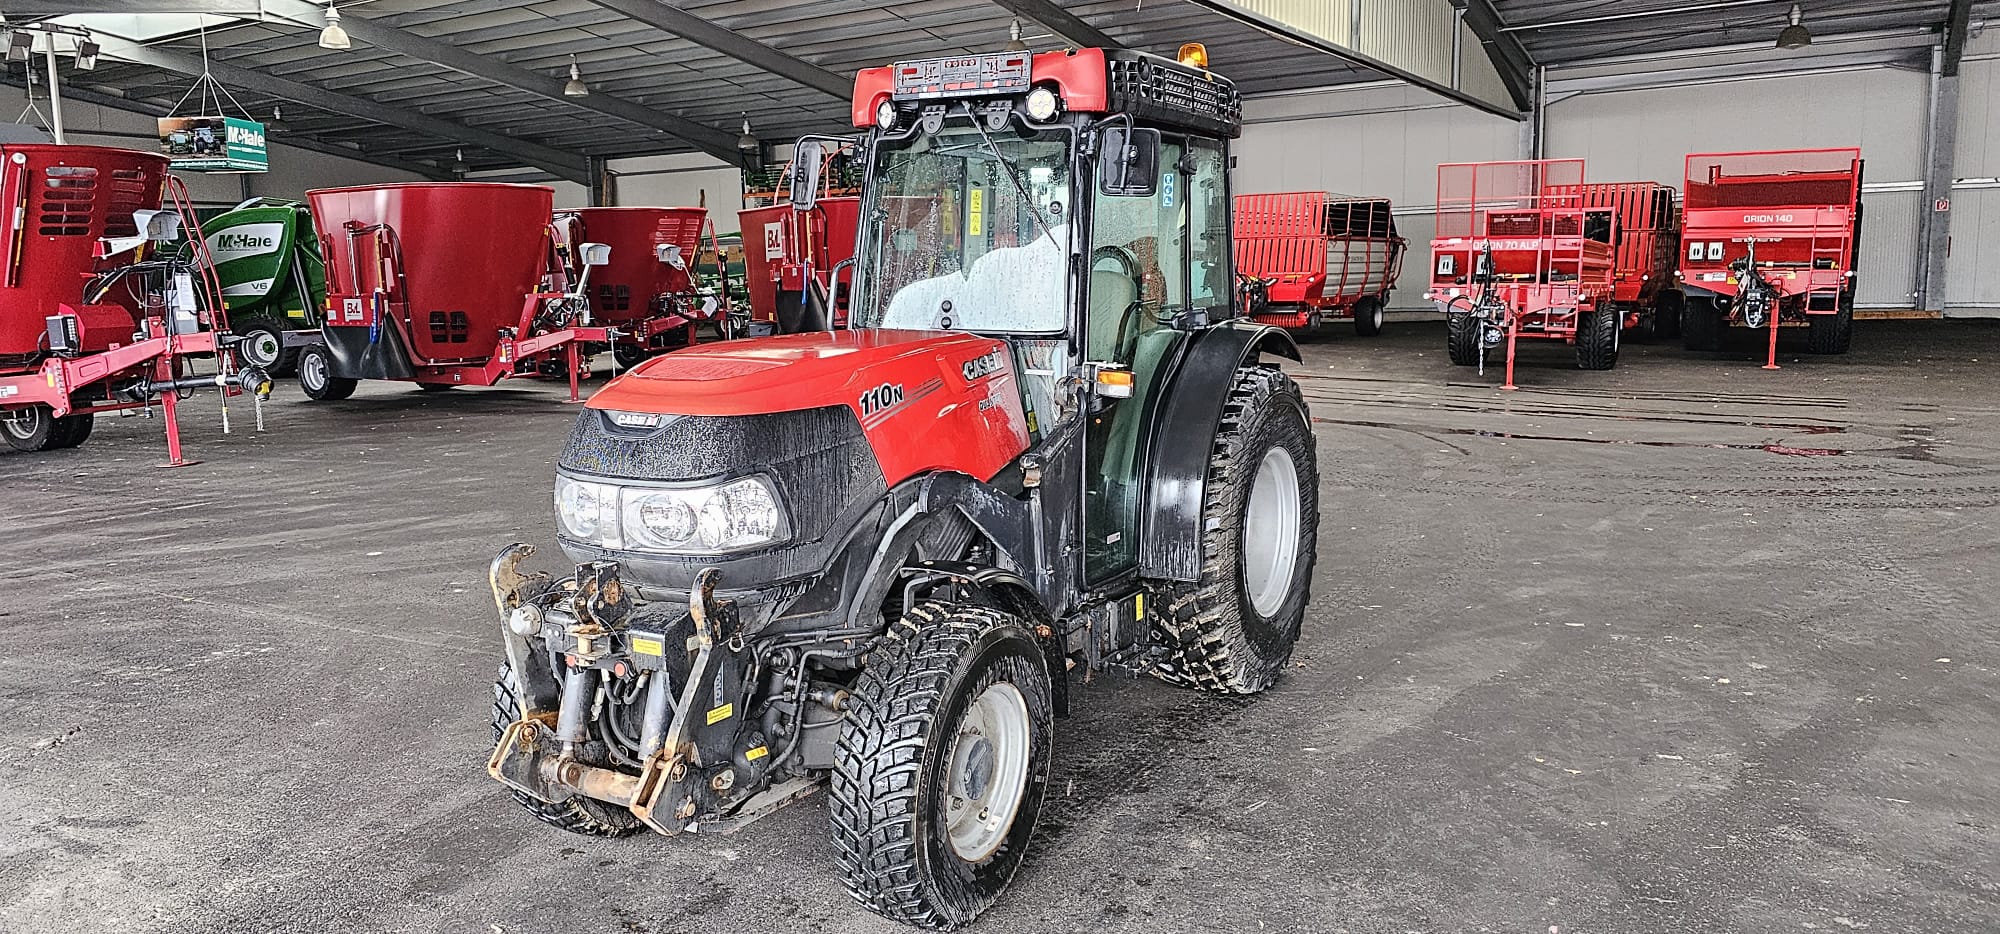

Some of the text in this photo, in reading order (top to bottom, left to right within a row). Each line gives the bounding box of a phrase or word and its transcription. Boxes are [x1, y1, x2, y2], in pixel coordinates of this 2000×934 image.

[227, 126, 265, 147] McHale
[1743, 214, 1793, 223] ORION 140
[217, 234, 272, 248] McHale
[1505, 240, 1518, 250] 70
[251, 282, 268, 290] V6
[963, 355, 994, 380] CASE
[617, 415, 646, 425] CASE
